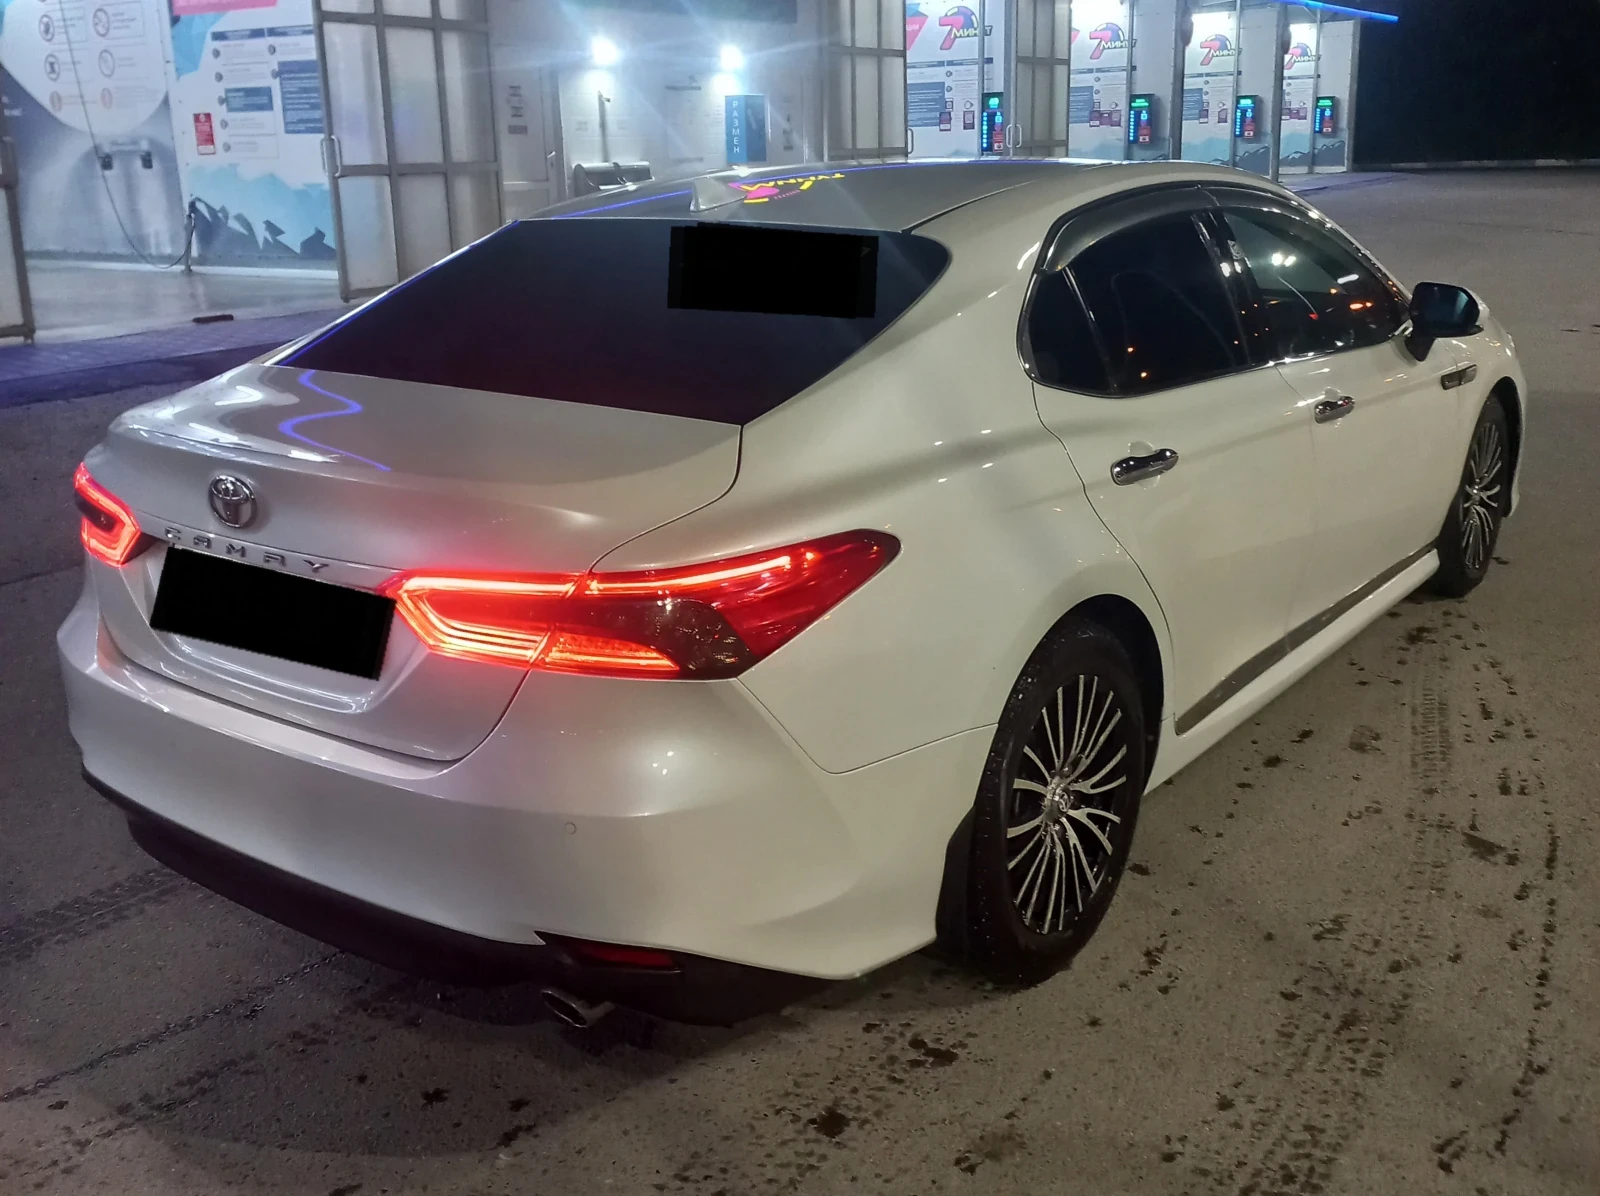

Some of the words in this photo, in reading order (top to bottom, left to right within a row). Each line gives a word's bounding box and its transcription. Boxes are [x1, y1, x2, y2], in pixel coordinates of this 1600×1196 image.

[951, 26, 993, 38] МИНТ
[1100, 39, 1137, 50] МИН
[1209, 48, 1242, 58] МИН
[732, 100, 740, 154] РАЗМЕН
[164, 526, 330, 574] CAMRY
